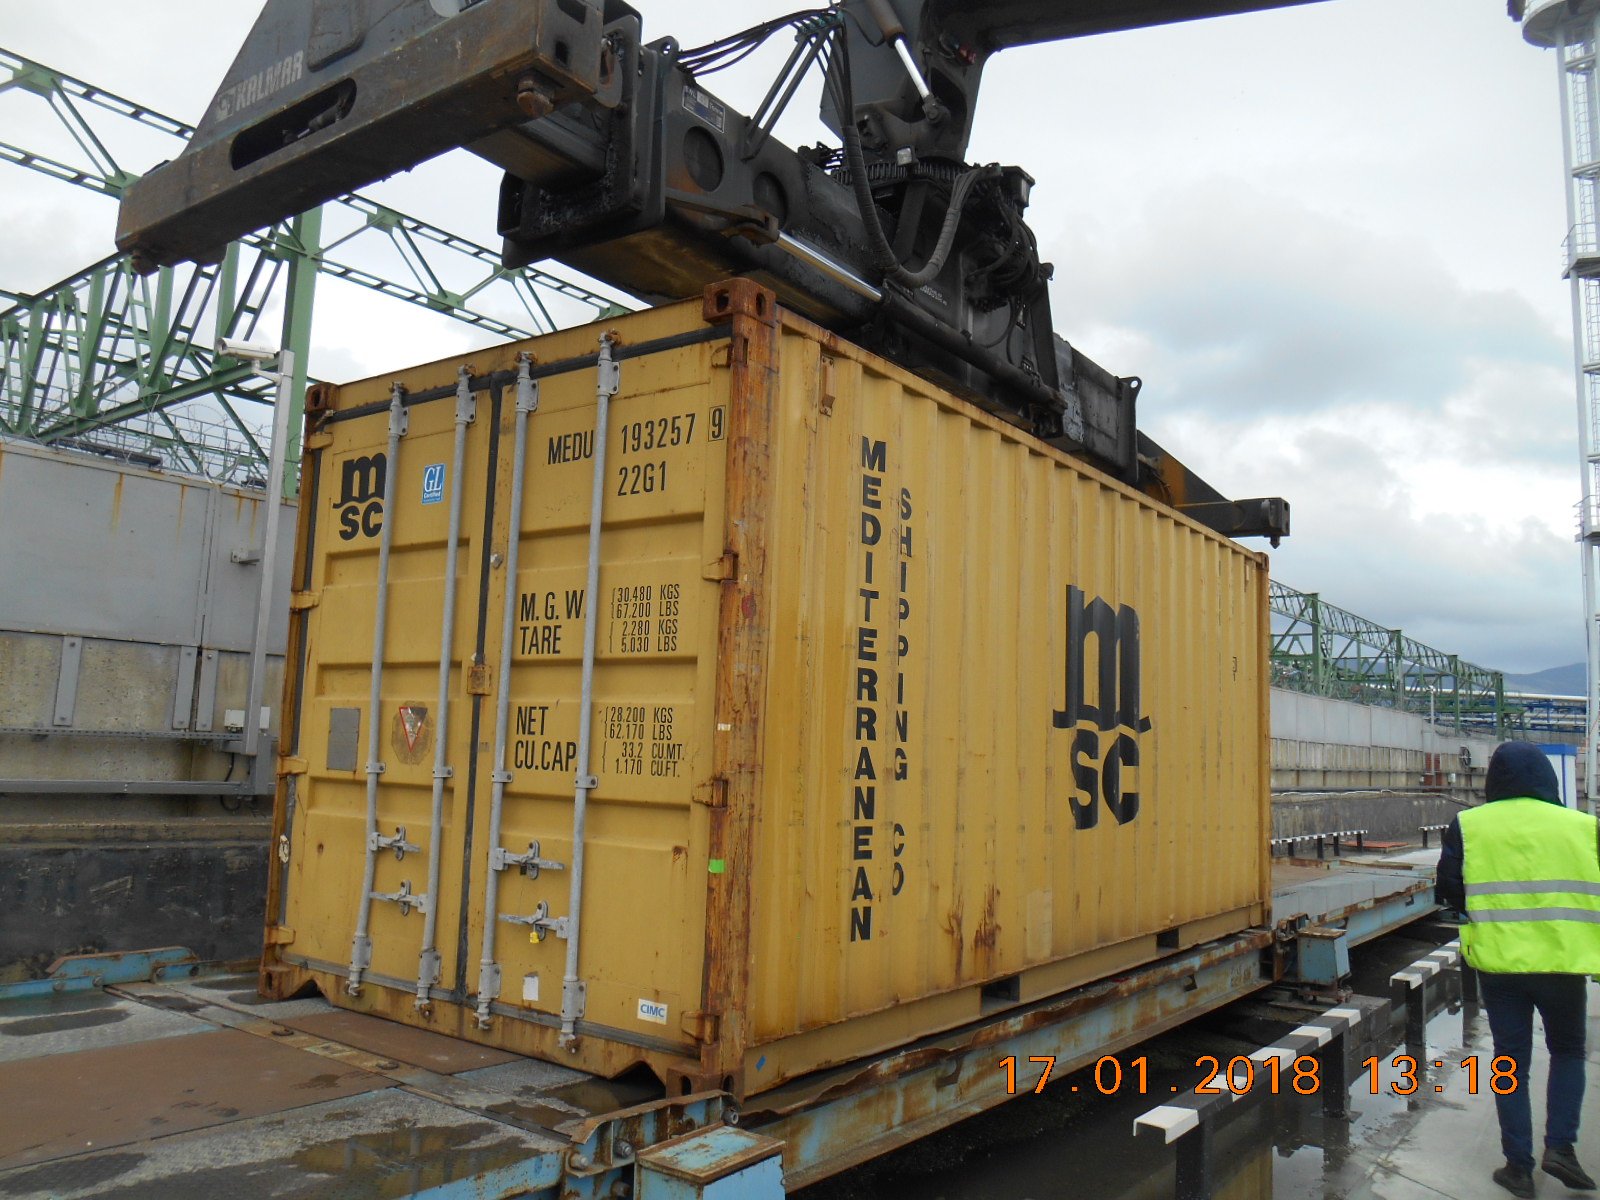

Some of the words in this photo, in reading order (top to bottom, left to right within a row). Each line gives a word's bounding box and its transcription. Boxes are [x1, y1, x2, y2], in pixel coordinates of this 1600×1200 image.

[235, 50, 304, 112] KALMAR
[547, 430, 594, 465] MEDU
[621, 413, 696, 454] 193257
[711, 408, 723, 439] 9
[424, 466, 442, 492] GL
[617, 461, 666, 496] 22G1
[660, 584, 680, 600] KGS
[659, 601, 679, 617] LBS
[658, 619, 678, 636] KGS
[894, 487, 913, 782] SHIPPING
[520, 625, 562, 655] TARE
[657, 635, 677, 652] LBS
[850, 435, 887, 942] MEDITERRANEAN
[516, 706, 549, 735] NET
[653, 707, 673, 724] KGS
[652, 724, 673, 741] LBS
[621, 742, 644, 758] 33.2
[640, 1003, 665, 1018] CIMC
